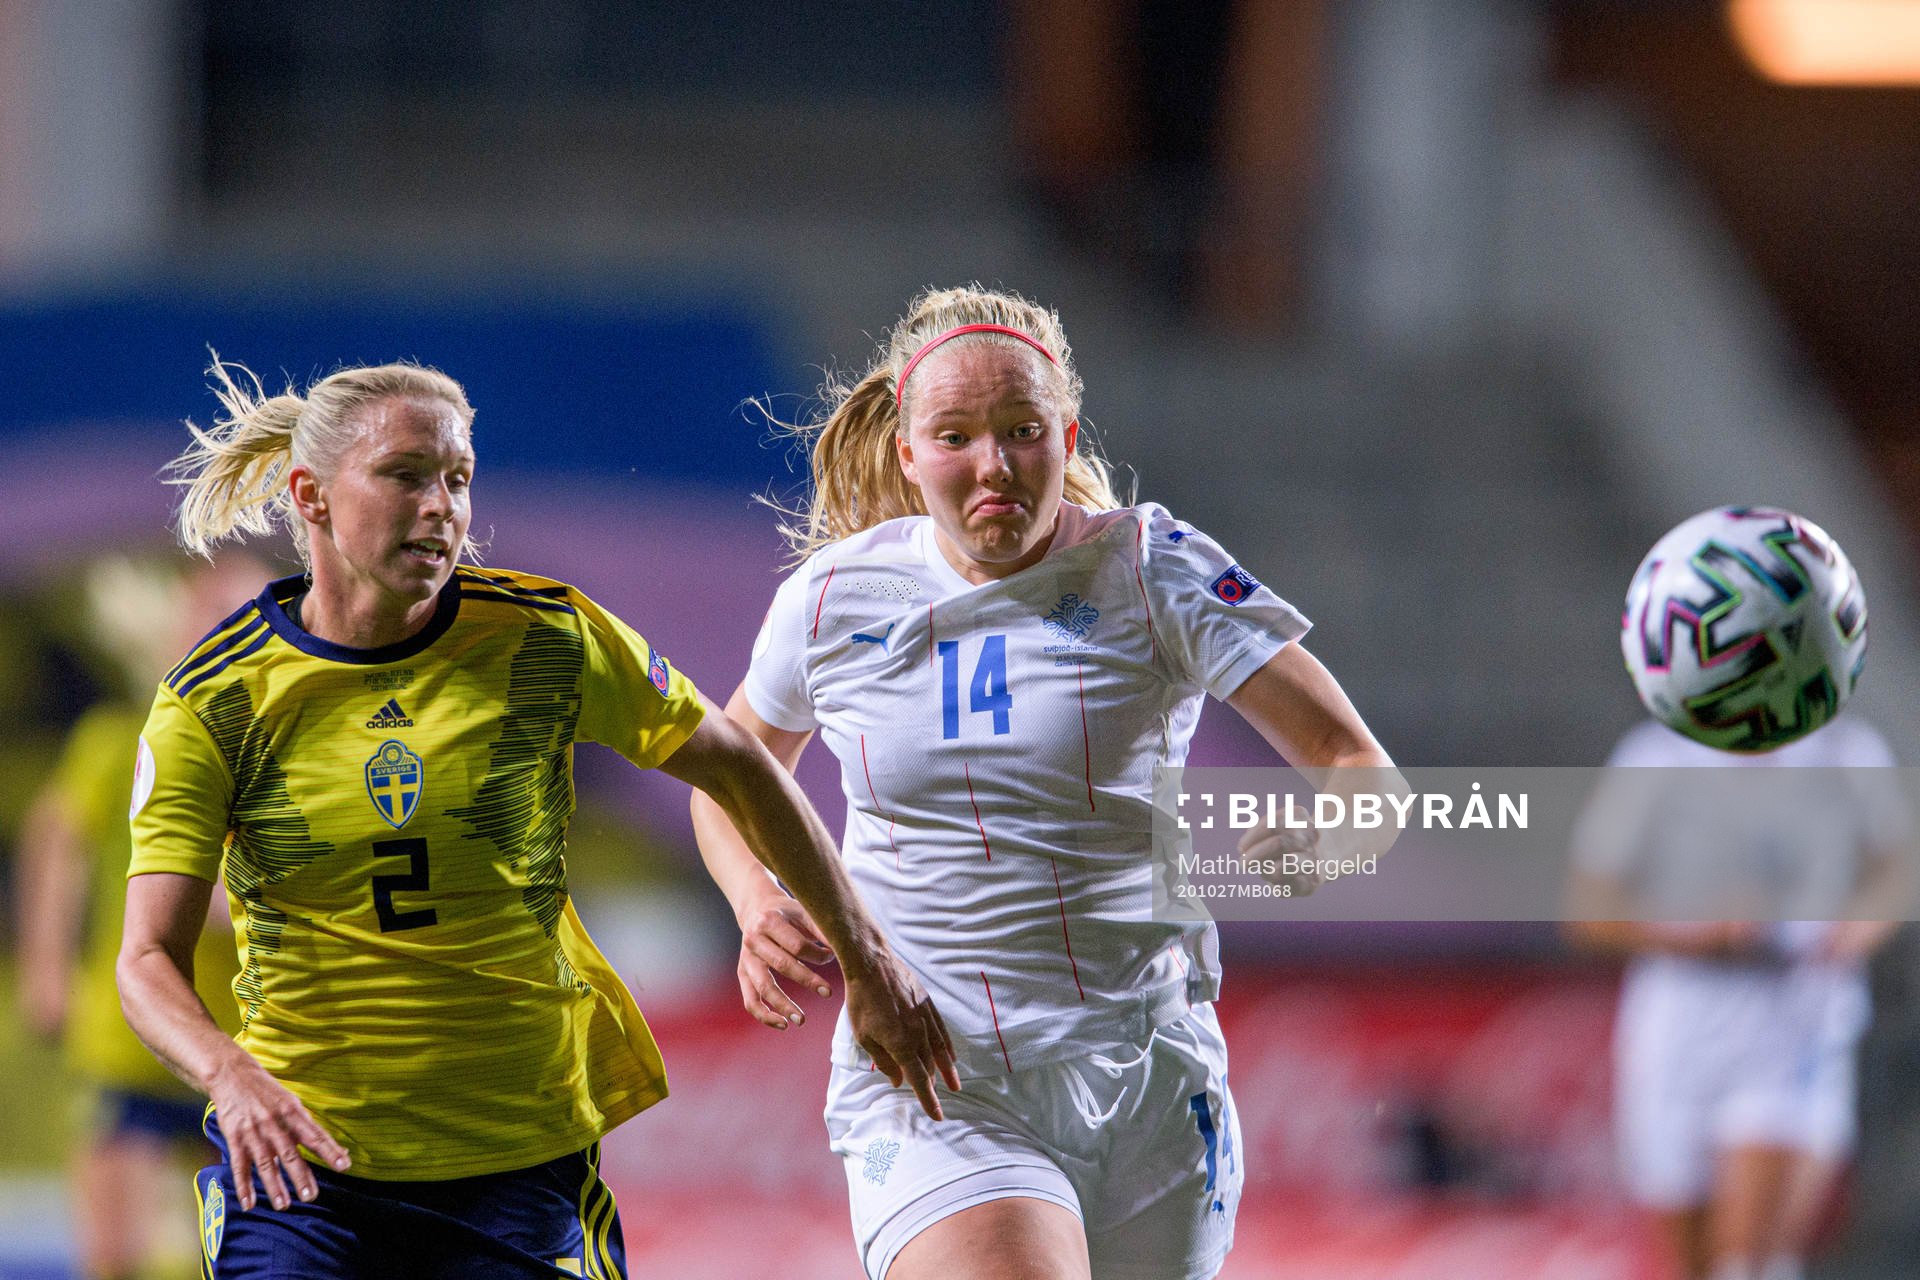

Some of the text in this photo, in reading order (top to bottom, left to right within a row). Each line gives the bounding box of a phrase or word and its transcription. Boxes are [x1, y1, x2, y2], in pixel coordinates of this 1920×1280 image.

[938, 634, 1012, 740] 14
[366, 718, 414, 729] adidas
[375, 765, 412, 775] SVERIGE
[372, 837, 438, 933] 2
